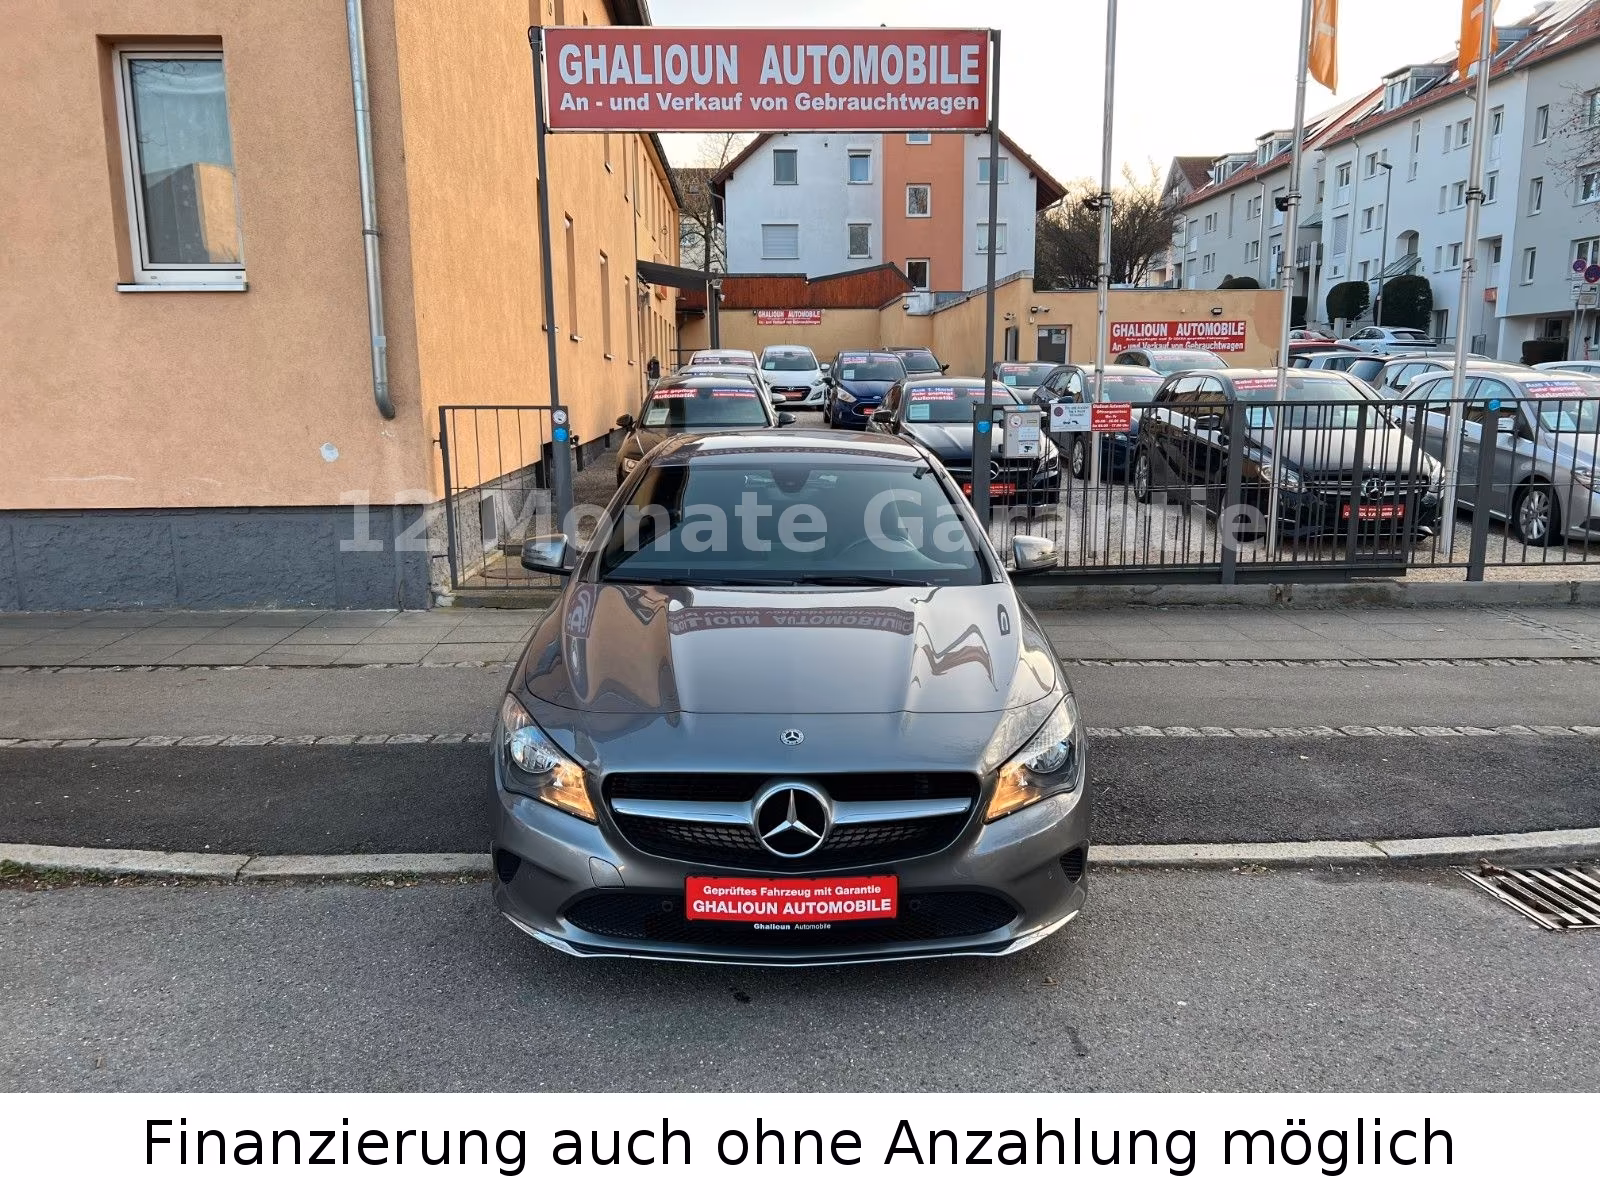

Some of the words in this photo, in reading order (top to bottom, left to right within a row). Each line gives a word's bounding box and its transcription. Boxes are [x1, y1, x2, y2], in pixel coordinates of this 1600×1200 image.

[559, 44, 738, 85] GHALIOUN
[759, 44, 980, 85] AUTOMOBILE
[560, 92, 588, 111] An
[610, 92, 649, 111] und
[657, 92, 742, 111] Verkauf
[750, 96, 787, 111] von
[795, 92, 980, 114] Gebrauchtwagen
[1112, 324, 1168, 337] GHALIOUN
[1176, 322, 1245, 336] AUTOMOBILE
[1112, 342, 1122, 351] An
[1184, 341, 1244, 352] Gebrauchtwagen
[703, 885, 757, 897] Geprüftes
[760, 886, 811, 898] Fahrzeug
[814, 886, 832, 896] mit
[835, 884, 881, 895] Garantie
[693, 900, 778, 915] GHALIOUN
[782, 898, 892, 914] AUTOMOBILE
